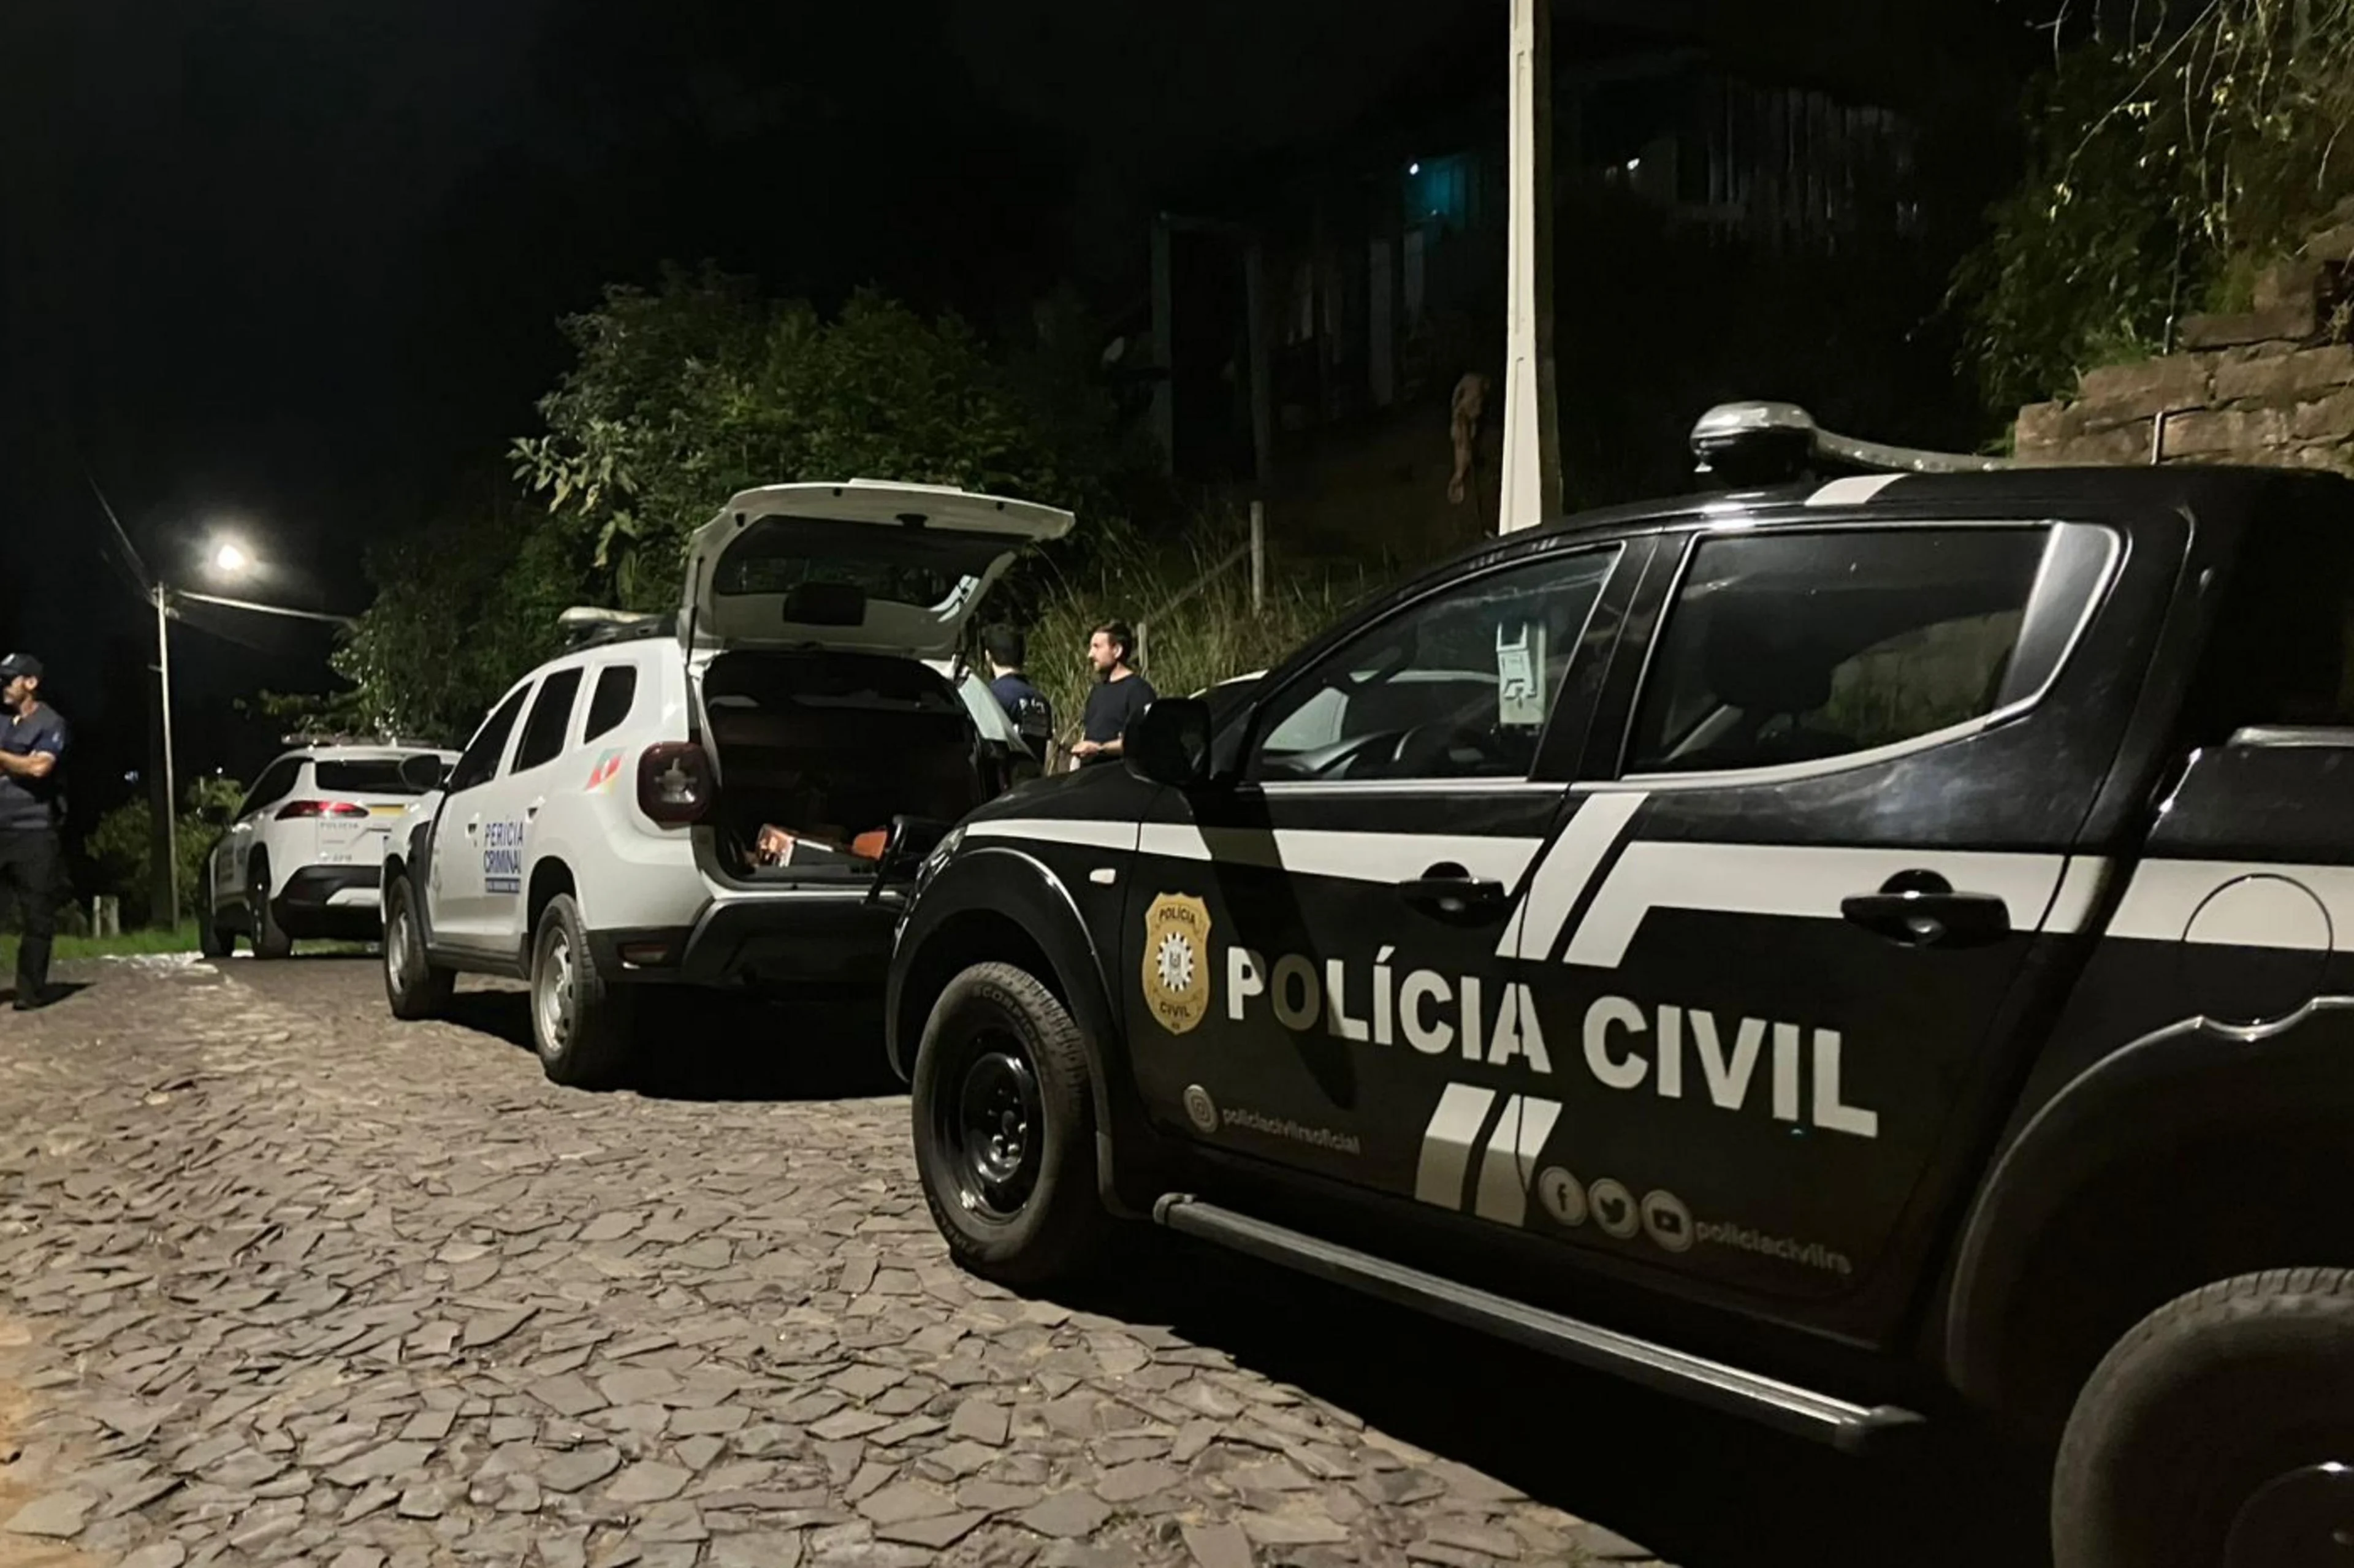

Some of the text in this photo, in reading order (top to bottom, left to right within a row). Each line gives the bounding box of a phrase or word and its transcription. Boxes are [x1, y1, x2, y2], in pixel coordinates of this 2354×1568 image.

[1160, 1001, 1191, 1017] CIVIL
[1228, 946, 1878, 1138] POLÍCIA CIVIL
